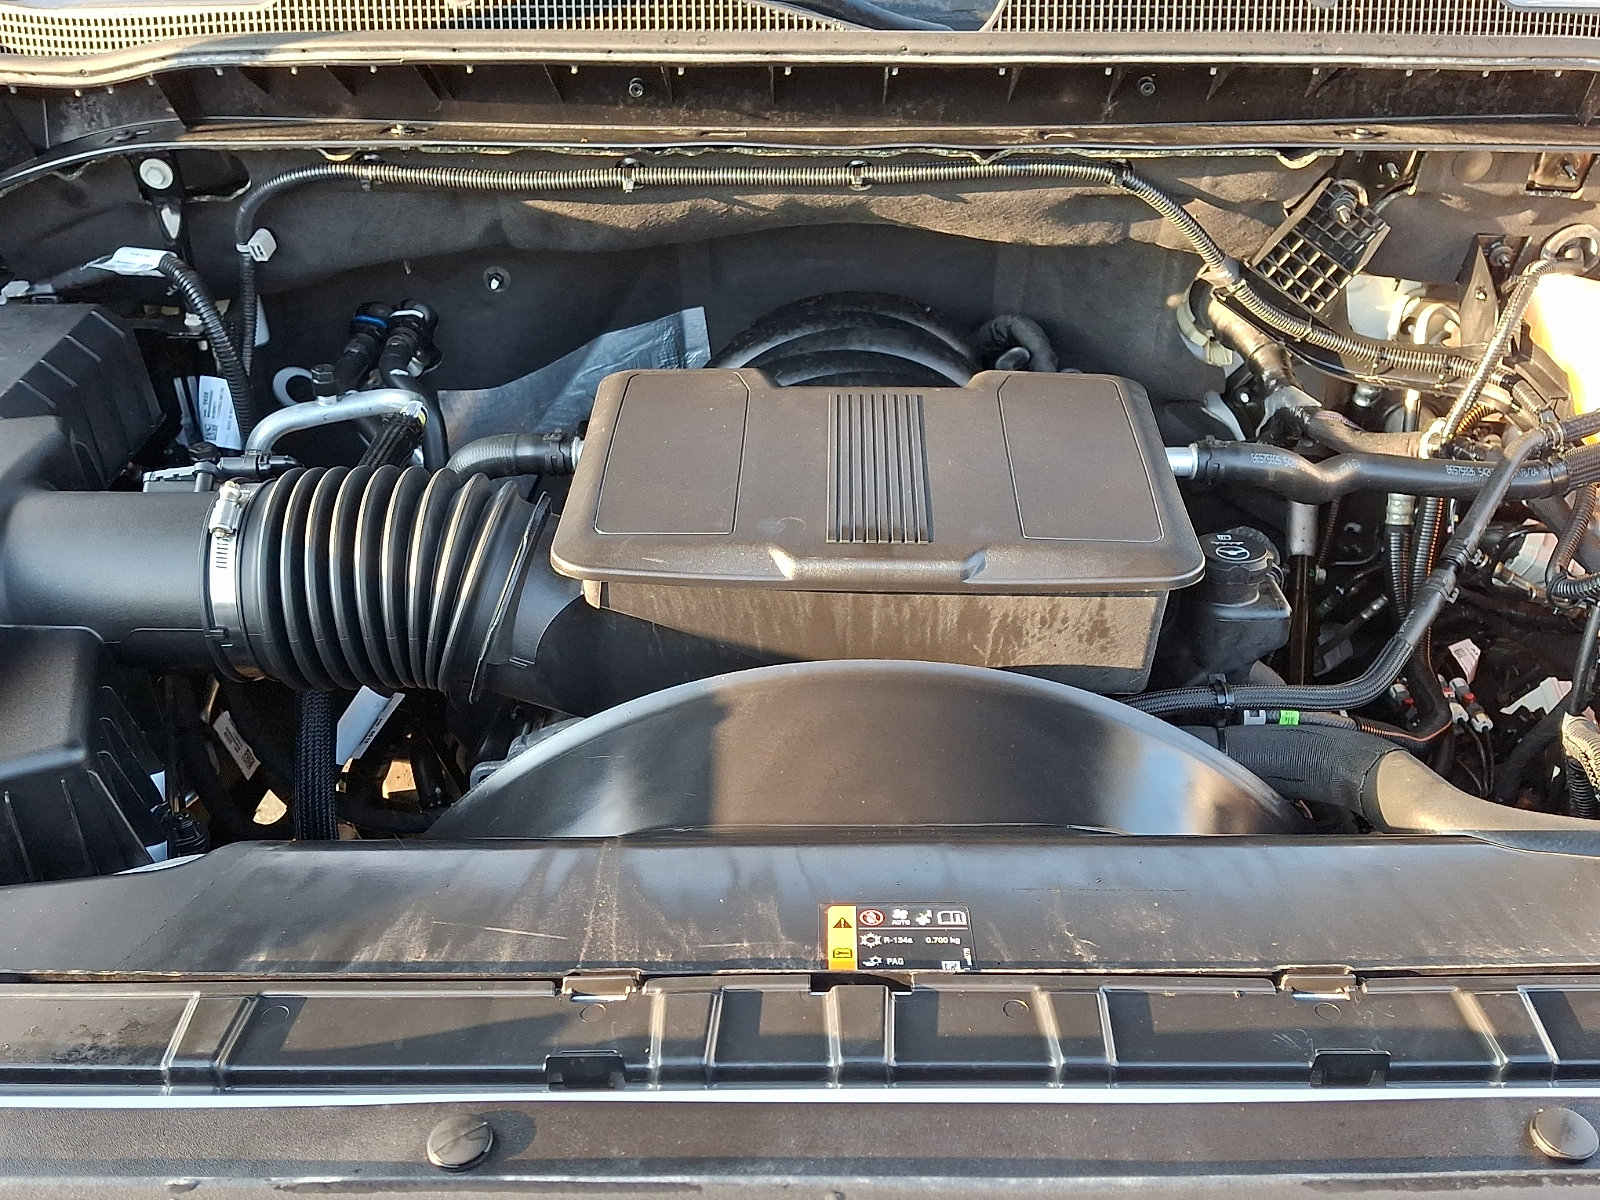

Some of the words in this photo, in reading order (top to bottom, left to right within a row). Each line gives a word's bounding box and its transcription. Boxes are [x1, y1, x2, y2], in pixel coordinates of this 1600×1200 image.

[883, 936, 914, 944] R-134a
[925, 936, 949, 944] 0.700
[949, 936, 961, 945] kg
[886, 957, 905, 966] PAG
